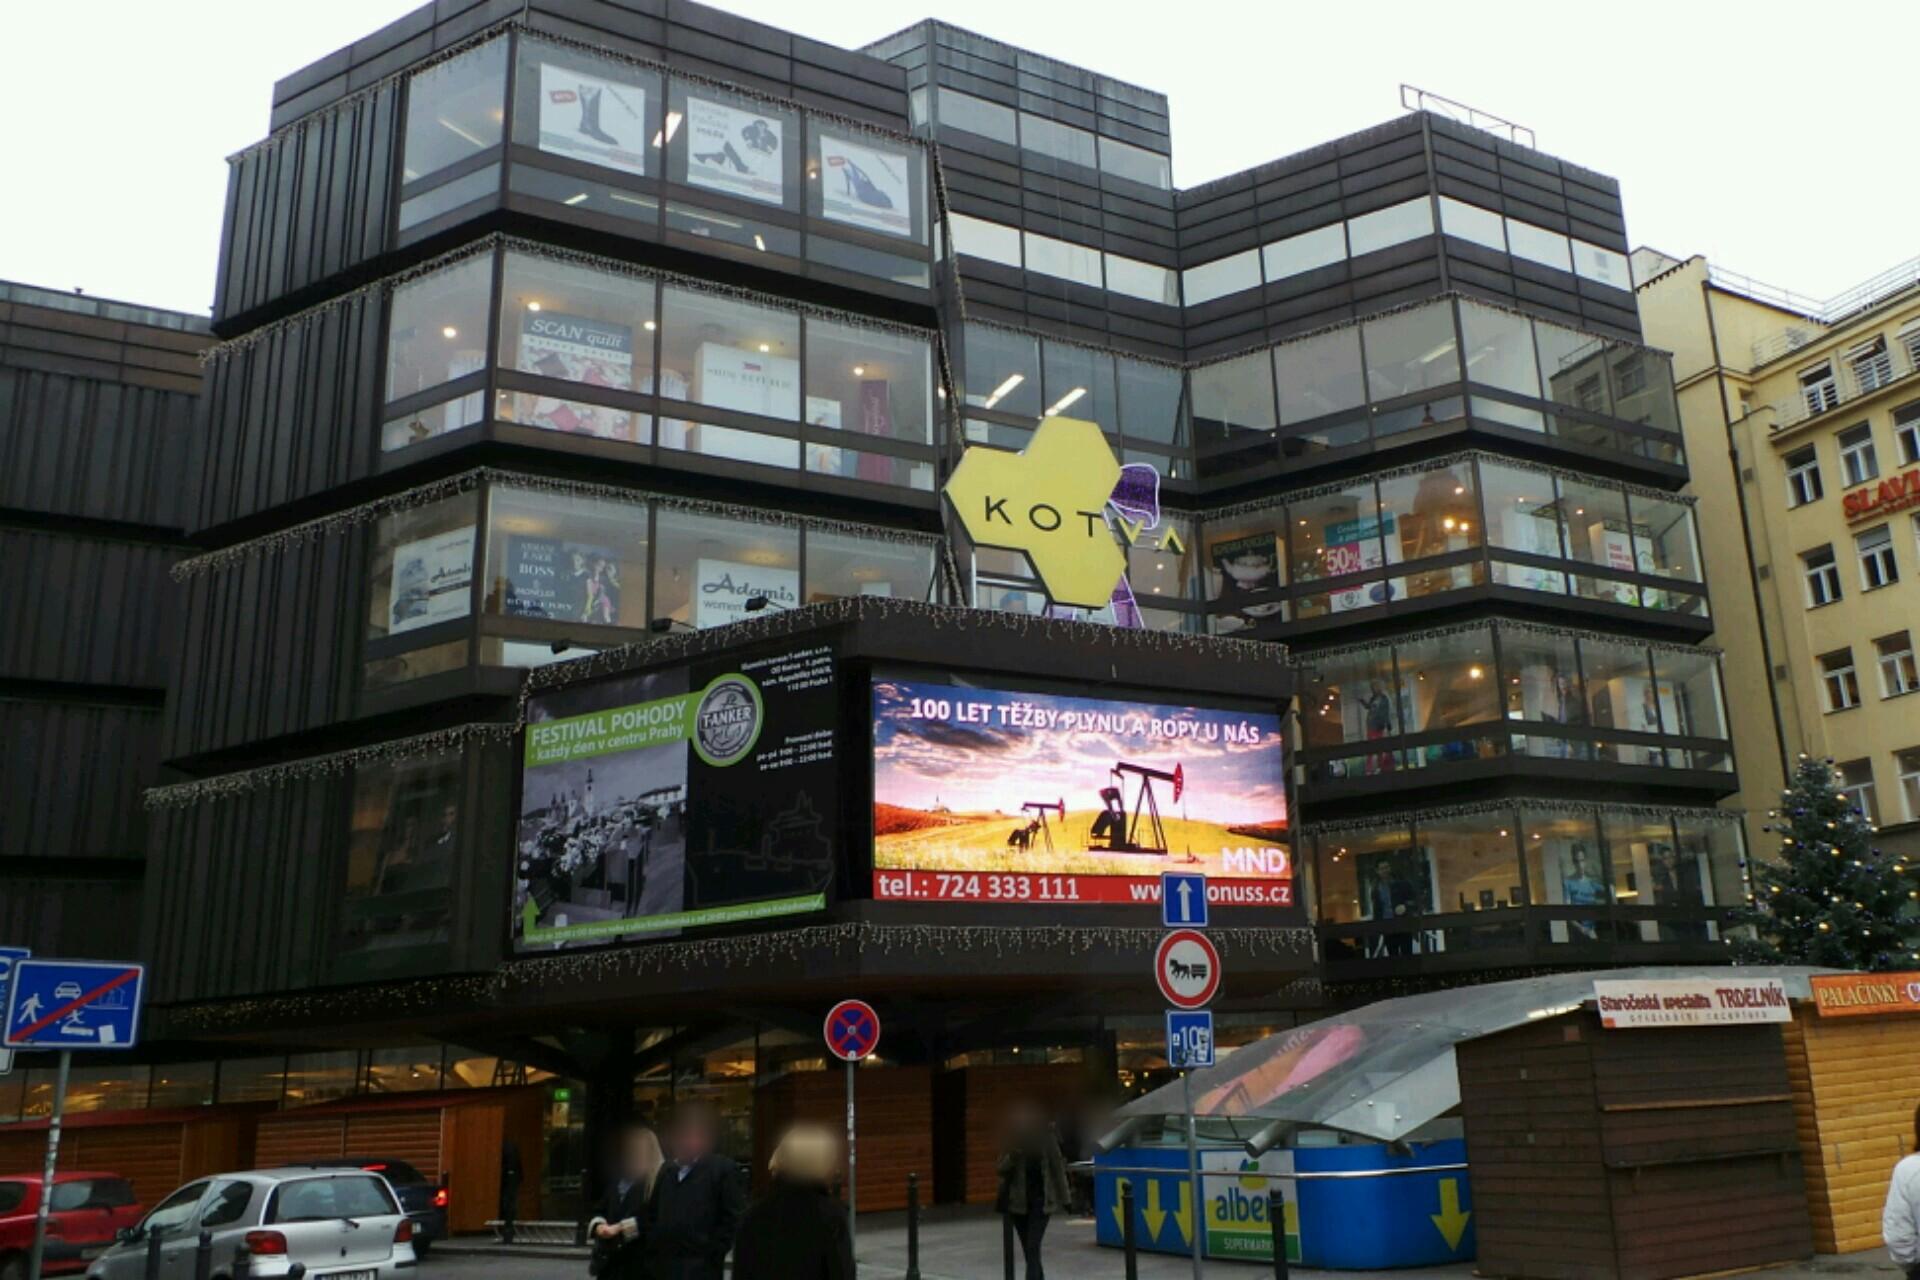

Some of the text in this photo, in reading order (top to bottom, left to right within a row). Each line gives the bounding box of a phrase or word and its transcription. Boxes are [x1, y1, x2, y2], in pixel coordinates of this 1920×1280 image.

[530, 319, 584, 340] SCAN
[985, 495, 1186, 556] KOTVA
[519, 562, 555, 577] BOSS
[1326, 546, 1362, 572] 50%
[702, 572, 795, 602] Adamis
[532, 700, 687, 747] FESTIVAL POHODY
[911, 697, 1260, 744] 100 LET TĚŽBY PLYNU A ROPY U NÁS
[537, 742, 571, 761] každý
[572, 740, 596, 754] den
[597, 740, 606, 750] v
[607, 732, 647, 748] centru
[649, 723, 685, 740] Prahy
[1222, 847, 1286, 874] MND
[879, 872, 928, 897] tel.:
[936, 874, 981, 898] 724
[988, 875, 1031, 899] 333
[1038, 877, 1080, 900] 111
[1715, 981, 1787, 1009] TRDELNÍK
[1815, 981, 1900, 1008] PALAČINKY
[1215, 1187, 1272, 1223] albe
